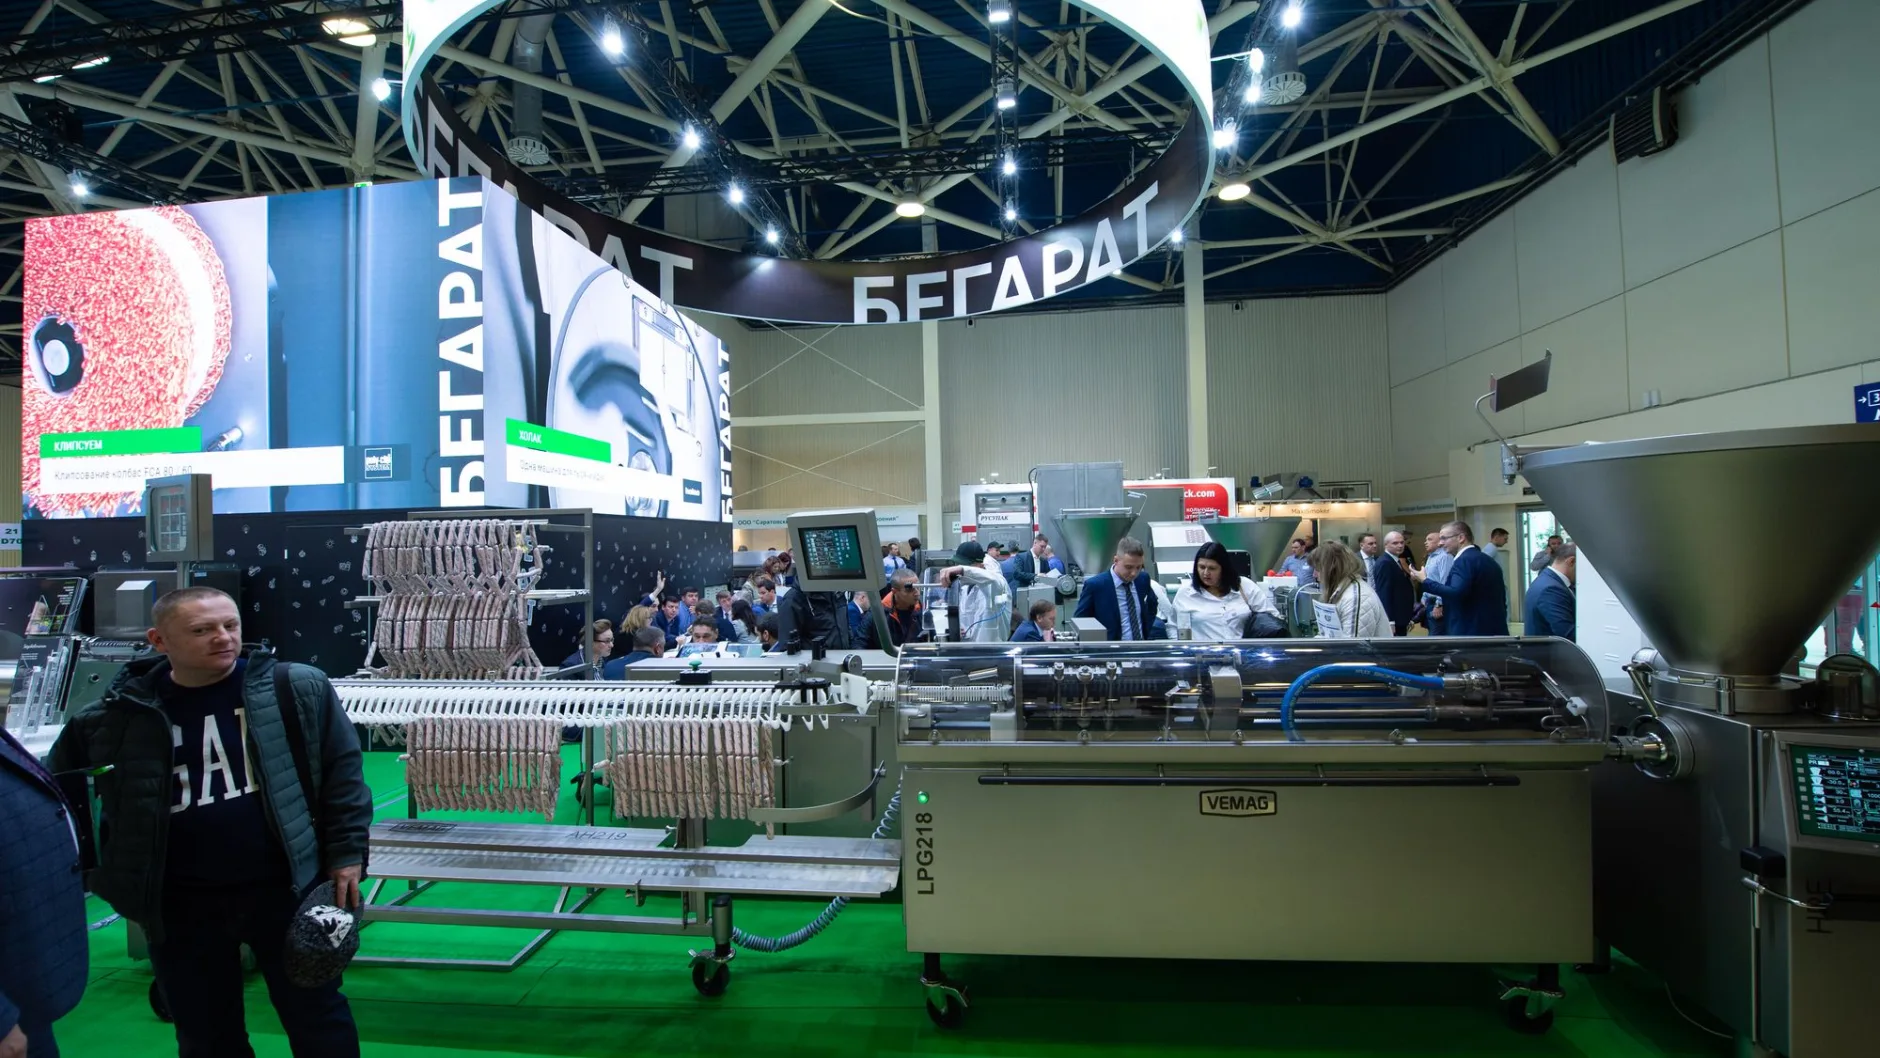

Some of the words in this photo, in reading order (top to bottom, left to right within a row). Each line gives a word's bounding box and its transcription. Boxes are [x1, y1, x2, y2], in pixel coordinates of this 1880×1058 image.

[853, 180, 1159, 324] БЕГАРАТ
[439, 177, 485, 508] БЕГАРАТ
[518, 430, 542, 444] ХОЛАК
[717, 338, 733, 523] БЕГАРАТ
[54, 440, 103, 451] КЛИПСУЕМ
[112, 468, 142, 478] колбас
[144, 466, 161, 477] FCA
[1184, 489, 1215, 498] ck.com
[1206, 796, 1269, 810] VEMAG
[565, 830, 628, 841] AH219
[915, 812, 934, 895] LPG218
